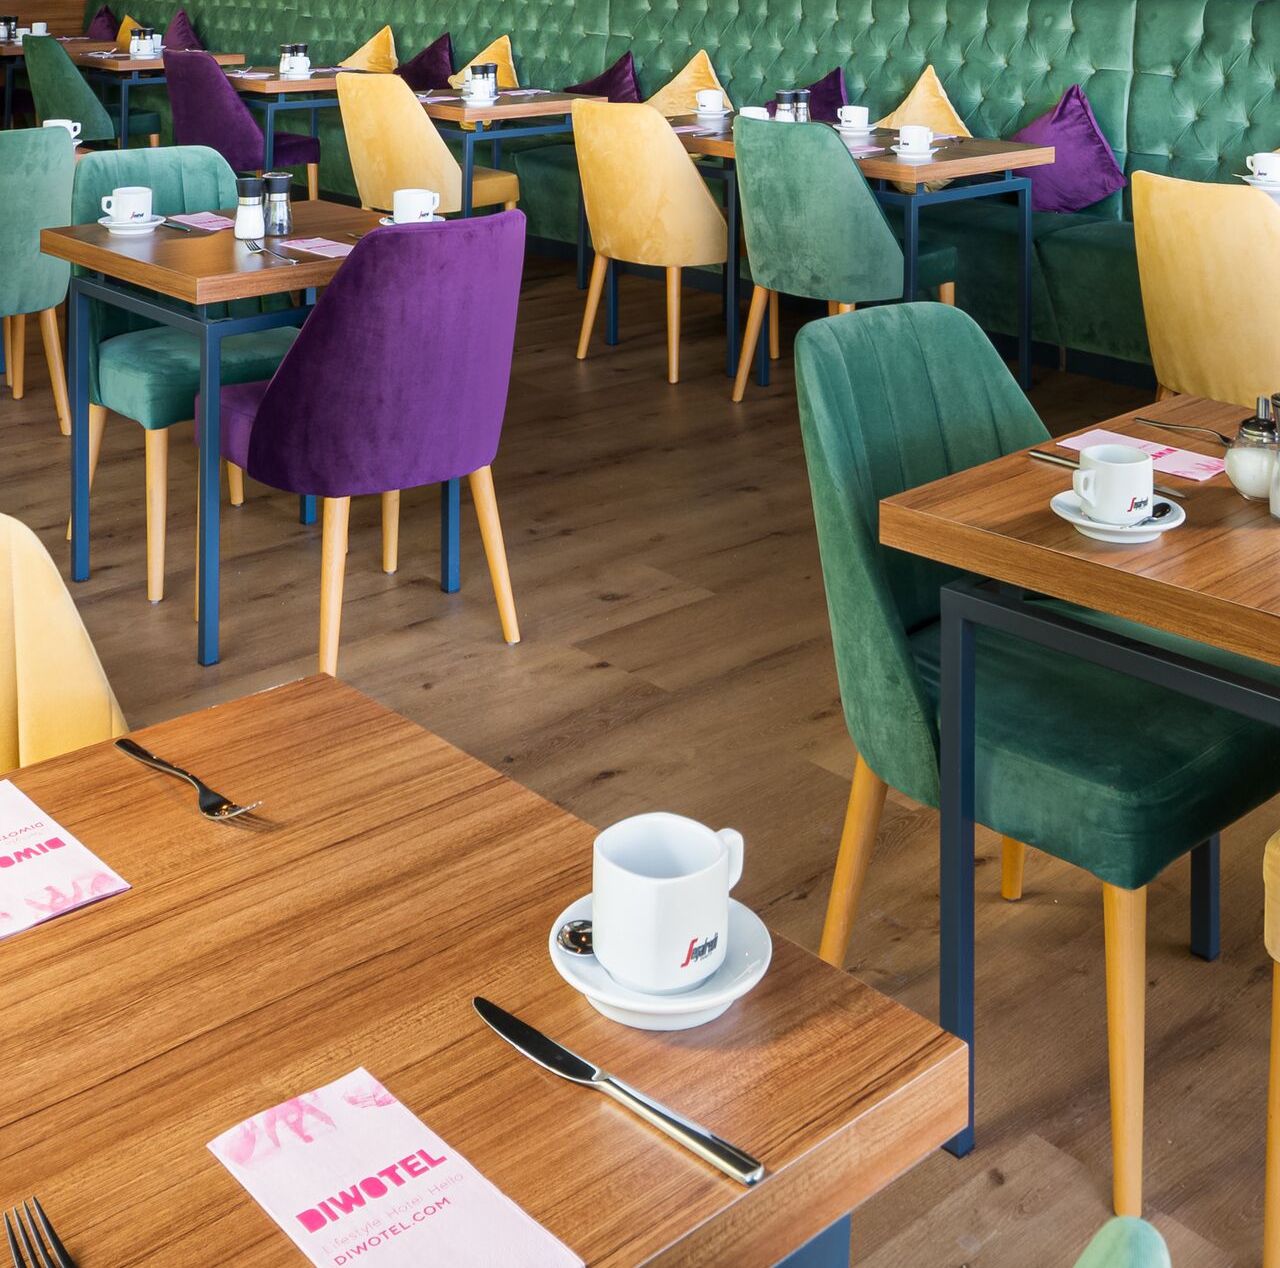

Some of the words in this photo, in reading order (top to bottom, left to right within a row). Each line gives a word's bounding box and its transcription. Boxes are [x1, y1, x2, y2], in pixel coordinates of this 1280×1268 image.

[295, 1148, 448, 1234] DIWOTEL
[428, 1173, 464, 1196] Hello
[334, 1197, 451, 1266] DIWOTEL.COM
